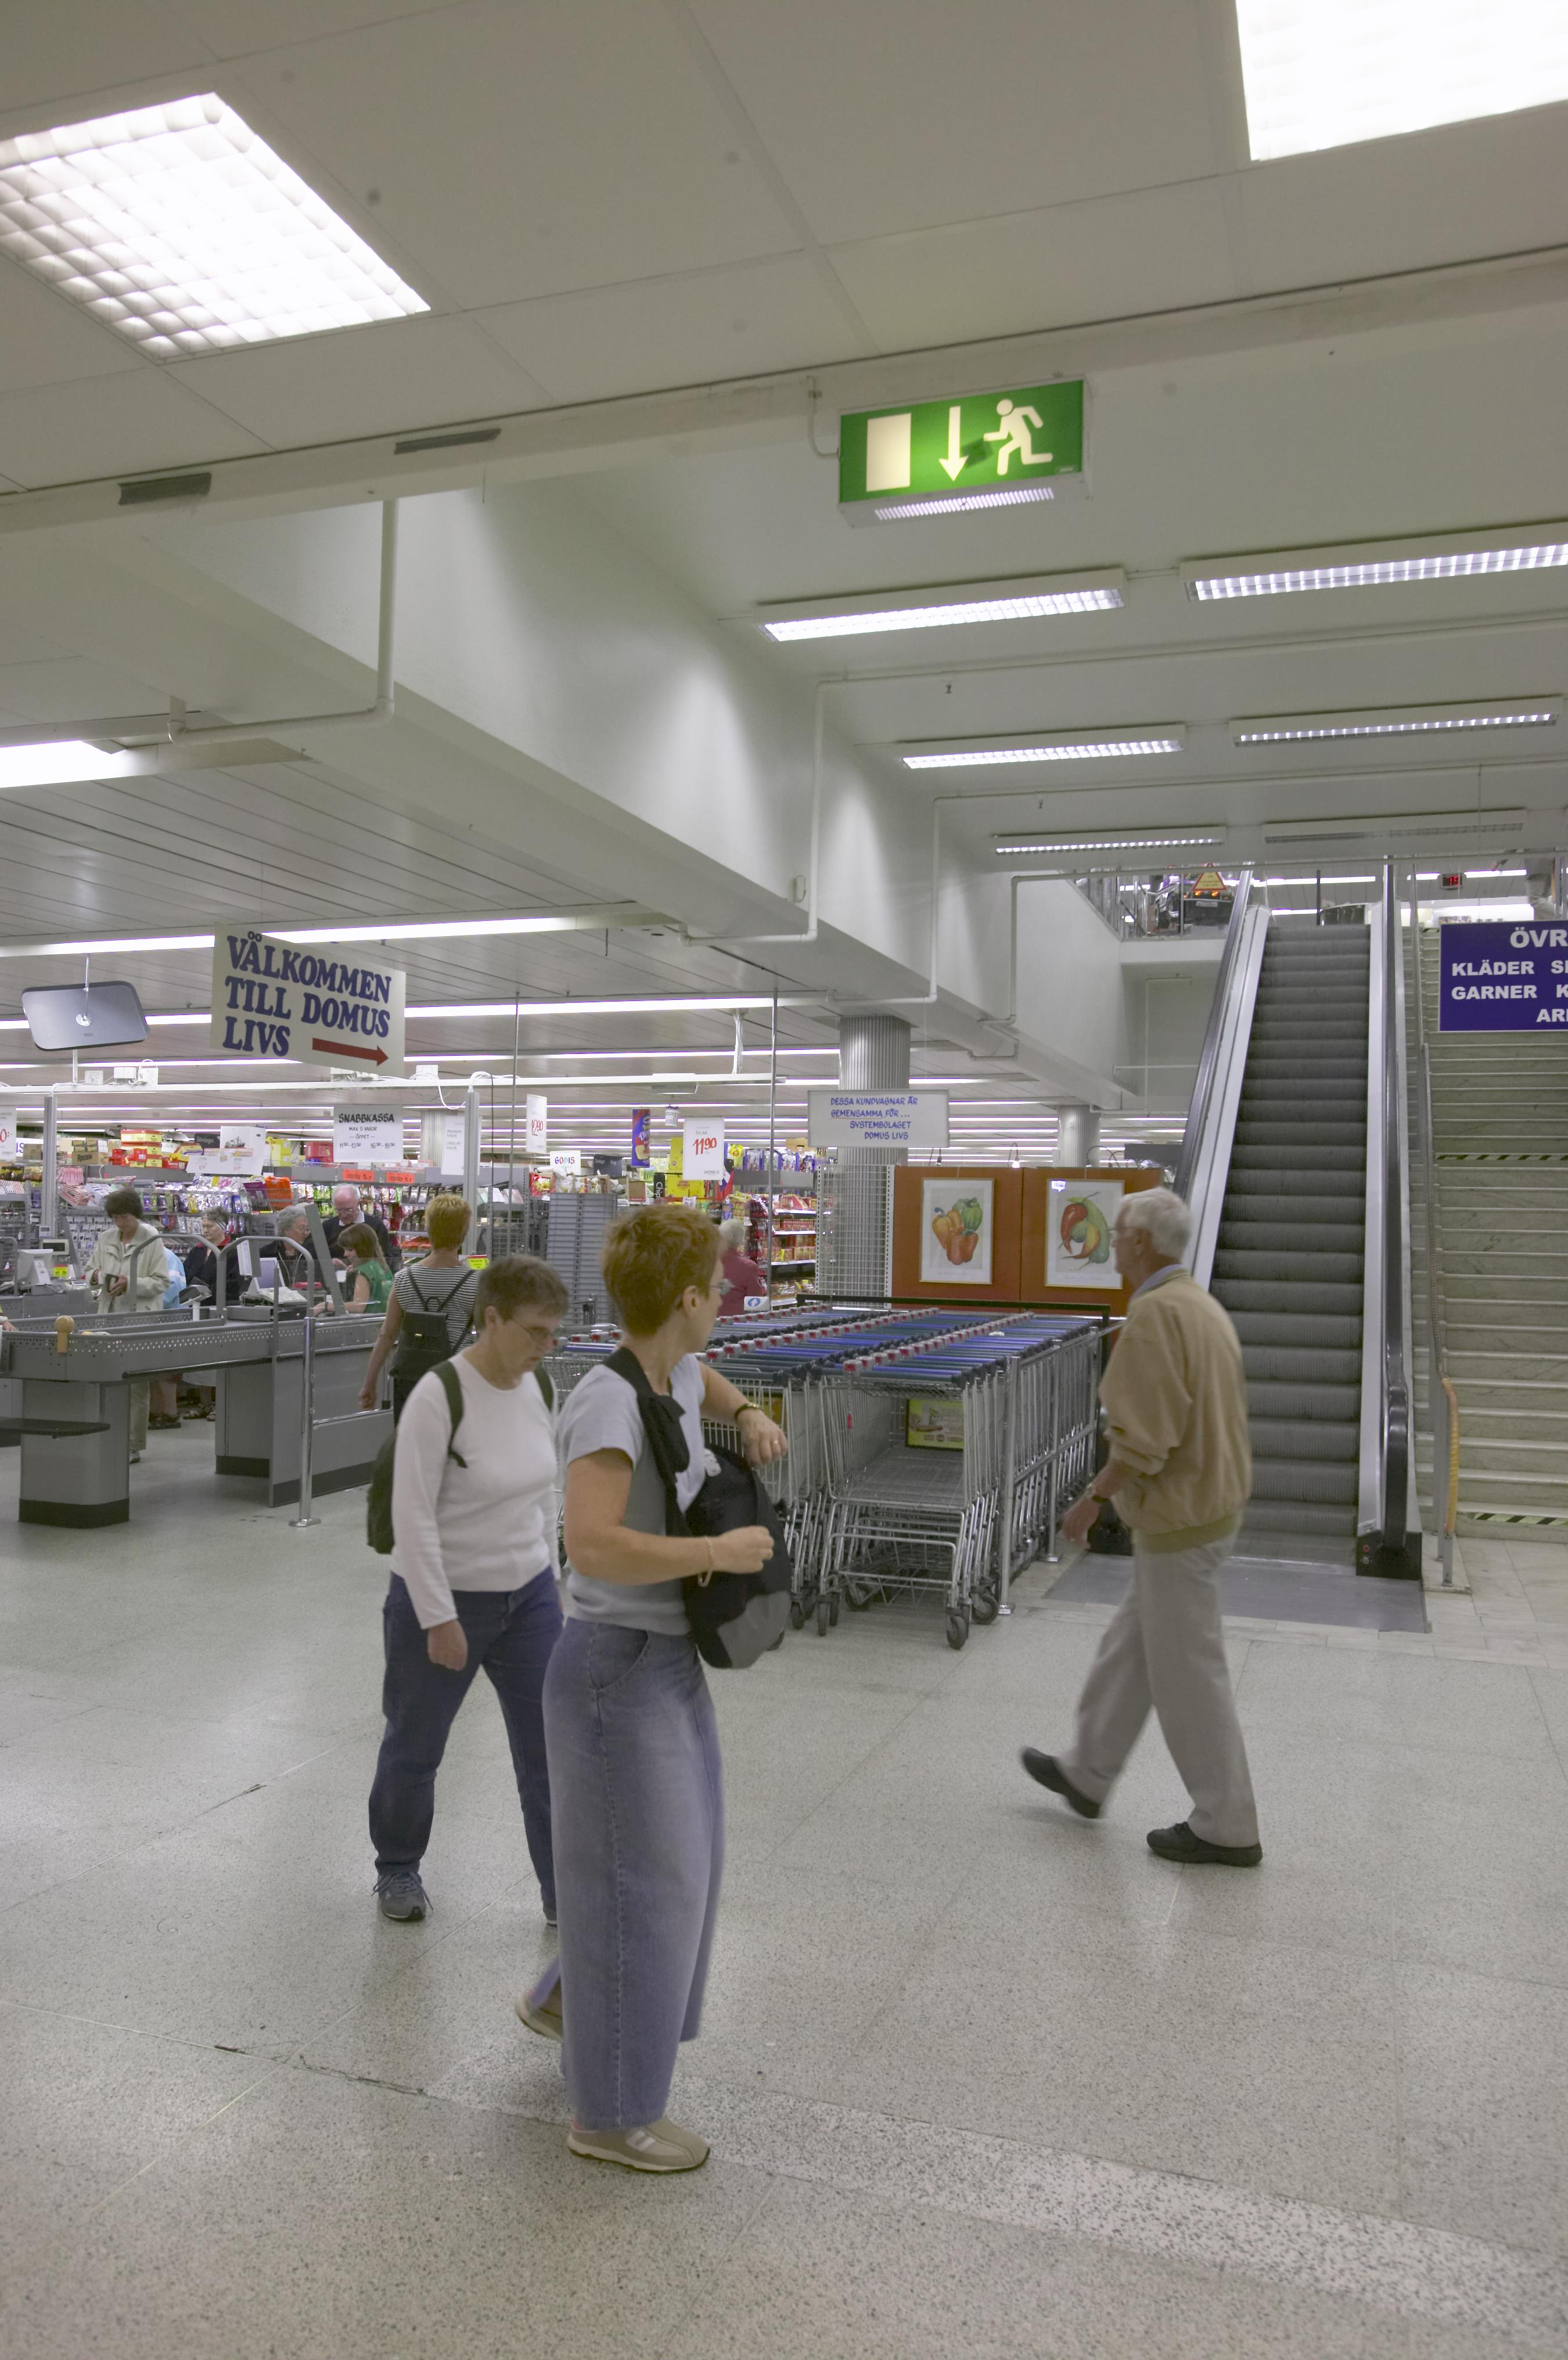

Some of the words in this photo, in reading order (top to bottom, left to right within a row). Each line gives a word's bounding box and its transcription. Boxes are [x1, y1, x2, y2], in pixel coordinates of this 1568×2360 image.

[226, 931, 391, 1003] VÄLKOMMEN
[1452, 959, 1534, 976] KLÄDER
[1551, 960, 1568, 974] S
[1452, 985, 1537, 1000] GARNER
[225, 976, 292, 1020] TILL
[301, 992, 390, 1038] DOMUS
[1536, 1009, 1568, 1023] AR
[222, 1016, 290, 1057] LIVS
[830, 1097, 854, 1106] DESSA
[856, 1097, 905, 1106] KUNDVAGNAR
[907, 1096, 918, 1105] ÄR
[339, 1113, 394, 1123] SNABBKASSA
[830, 1109, 883, 1118] GEMENSAMMA
[850, 1121, 911, 1129] SYSTEMBOLAGET
[554, 1156, 575, 1165] GODIS
